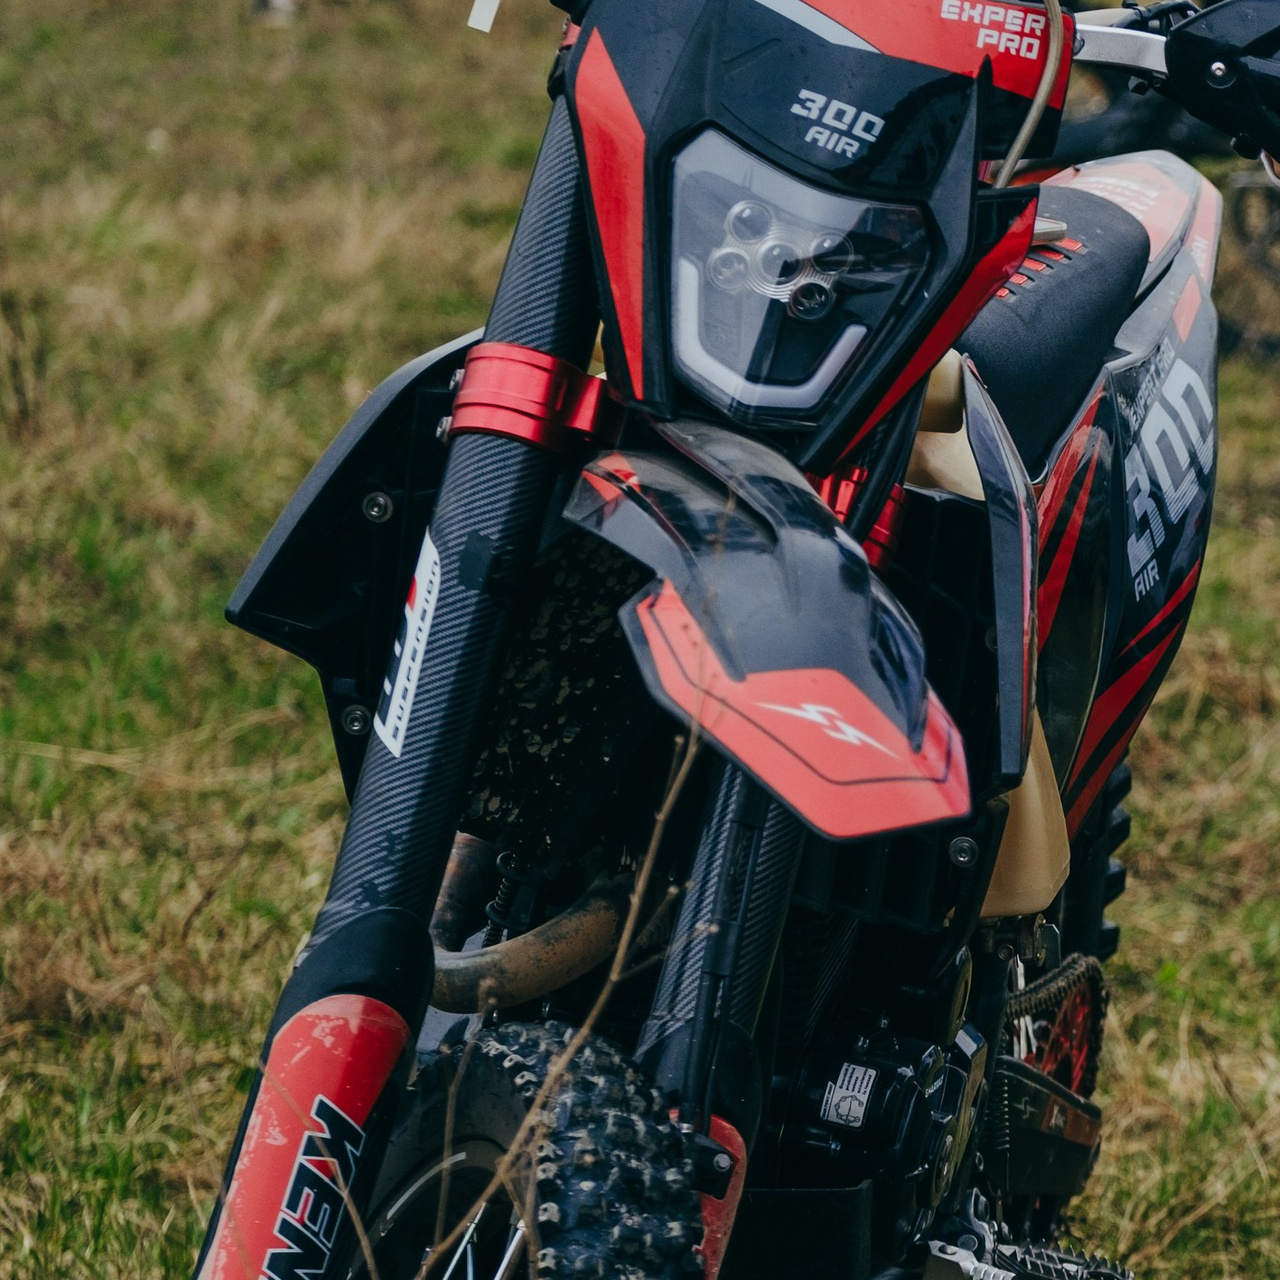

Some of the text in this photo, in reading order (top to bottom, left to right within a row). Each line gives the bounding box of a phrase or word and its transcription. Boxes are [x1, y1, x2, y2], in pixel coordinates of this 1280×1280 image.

[976, 27, 1041, 61] PRO
[789, 88, 886, 143] 300
[804, 125, 861, 159] AIR
[1134, 559, 1160, 602] AIR
